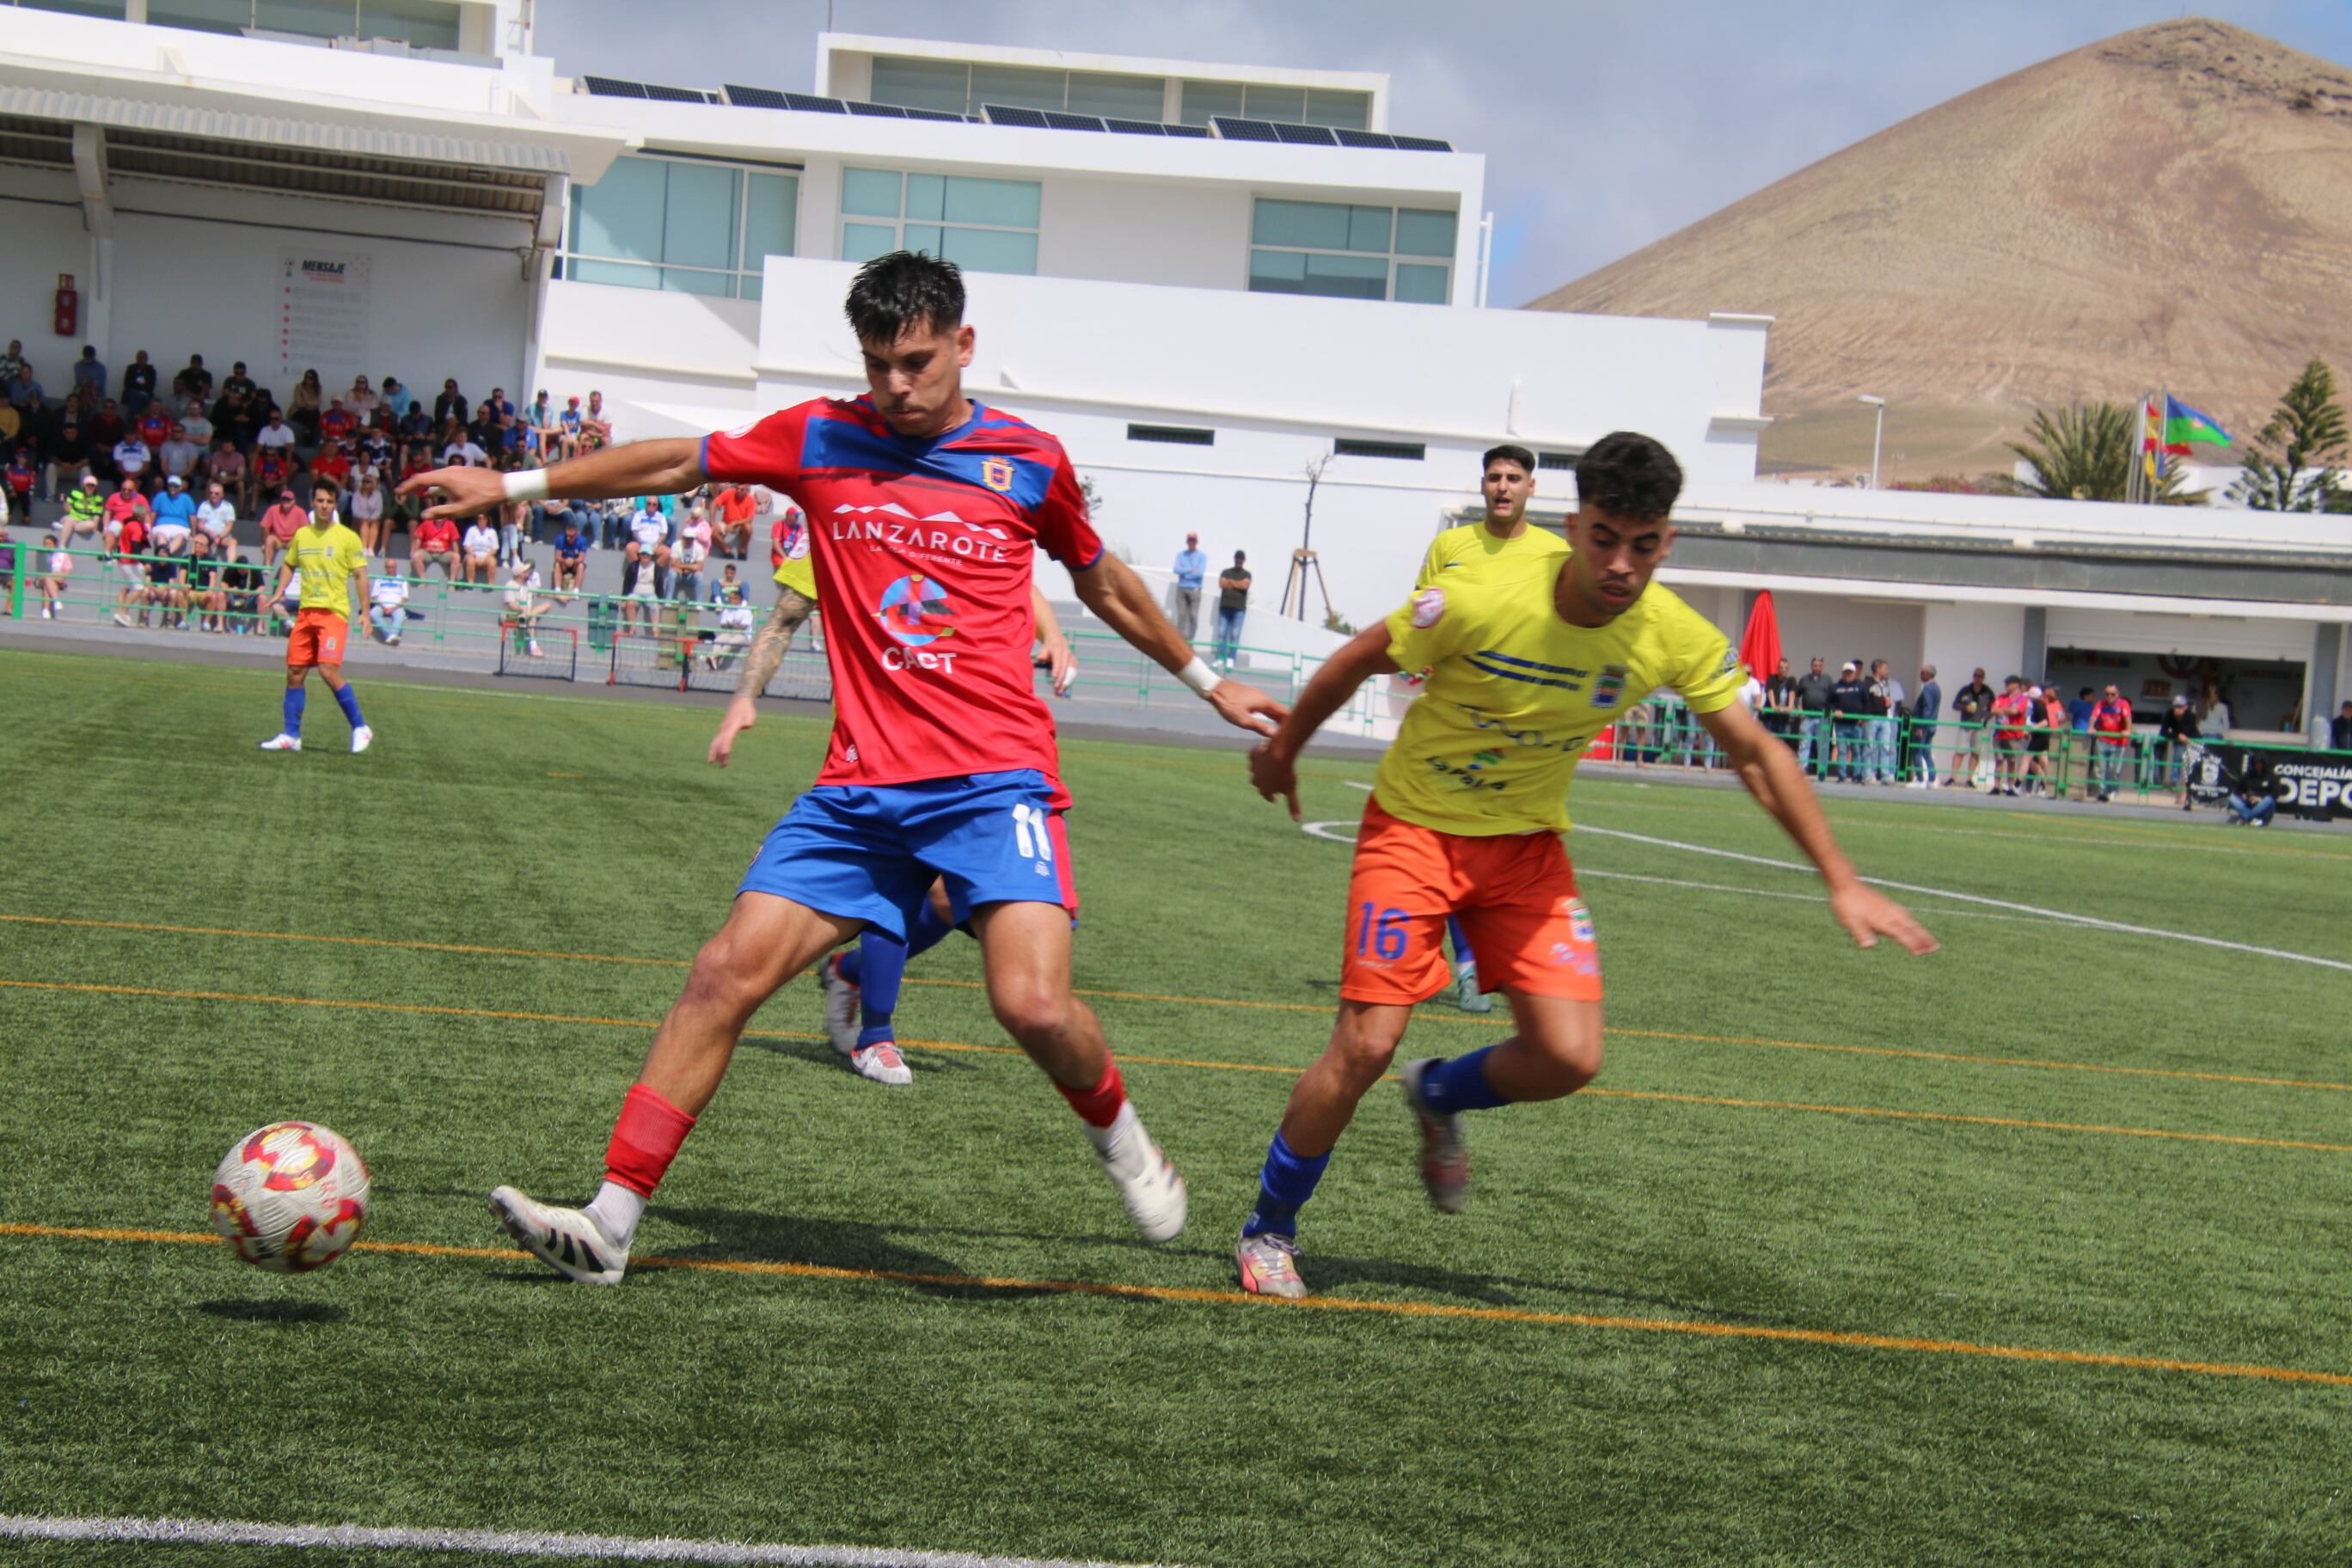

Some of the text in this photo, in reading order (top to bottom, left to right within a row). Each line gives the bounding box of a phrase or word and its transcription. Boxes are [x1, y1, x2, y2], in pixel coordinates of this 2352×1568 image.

[302, 260, 346, 275] MENSAJE
[832, 521, 1008, 562] LANZAROTE
[882, 646, 958, 675] CACT
[1012, 803, 1051, 861] 11
[1357, 902, 1411, 959] 16
